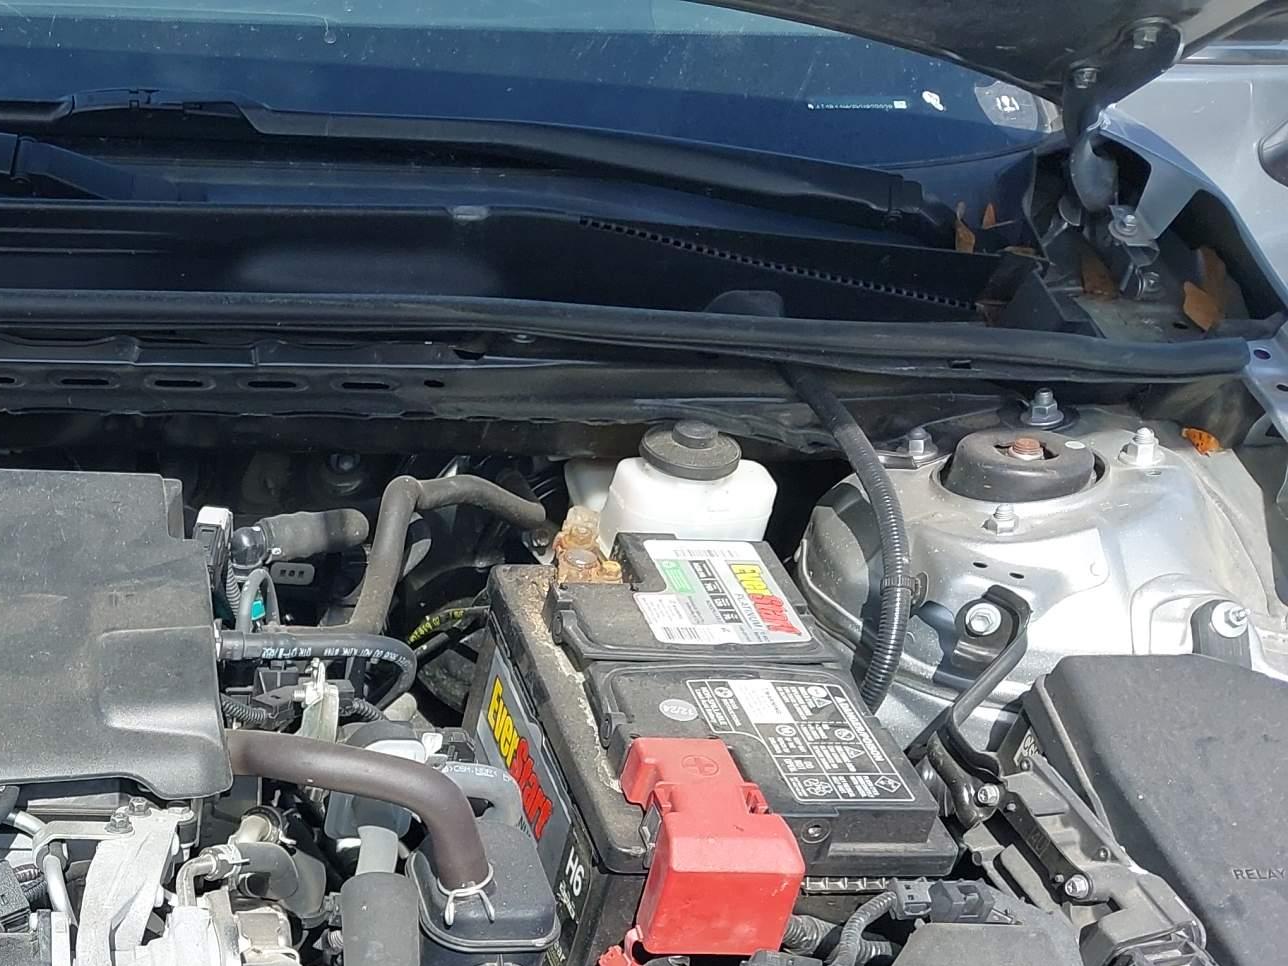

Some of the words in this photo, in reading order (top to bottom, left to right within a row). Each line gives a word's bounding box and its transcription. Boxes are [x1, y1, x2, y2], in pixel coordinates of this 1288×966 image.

[487, 675, 553, 841] EverStart
[566, 846, 585, 897] H6
[1232, 867, 1286, 880] RELAY
